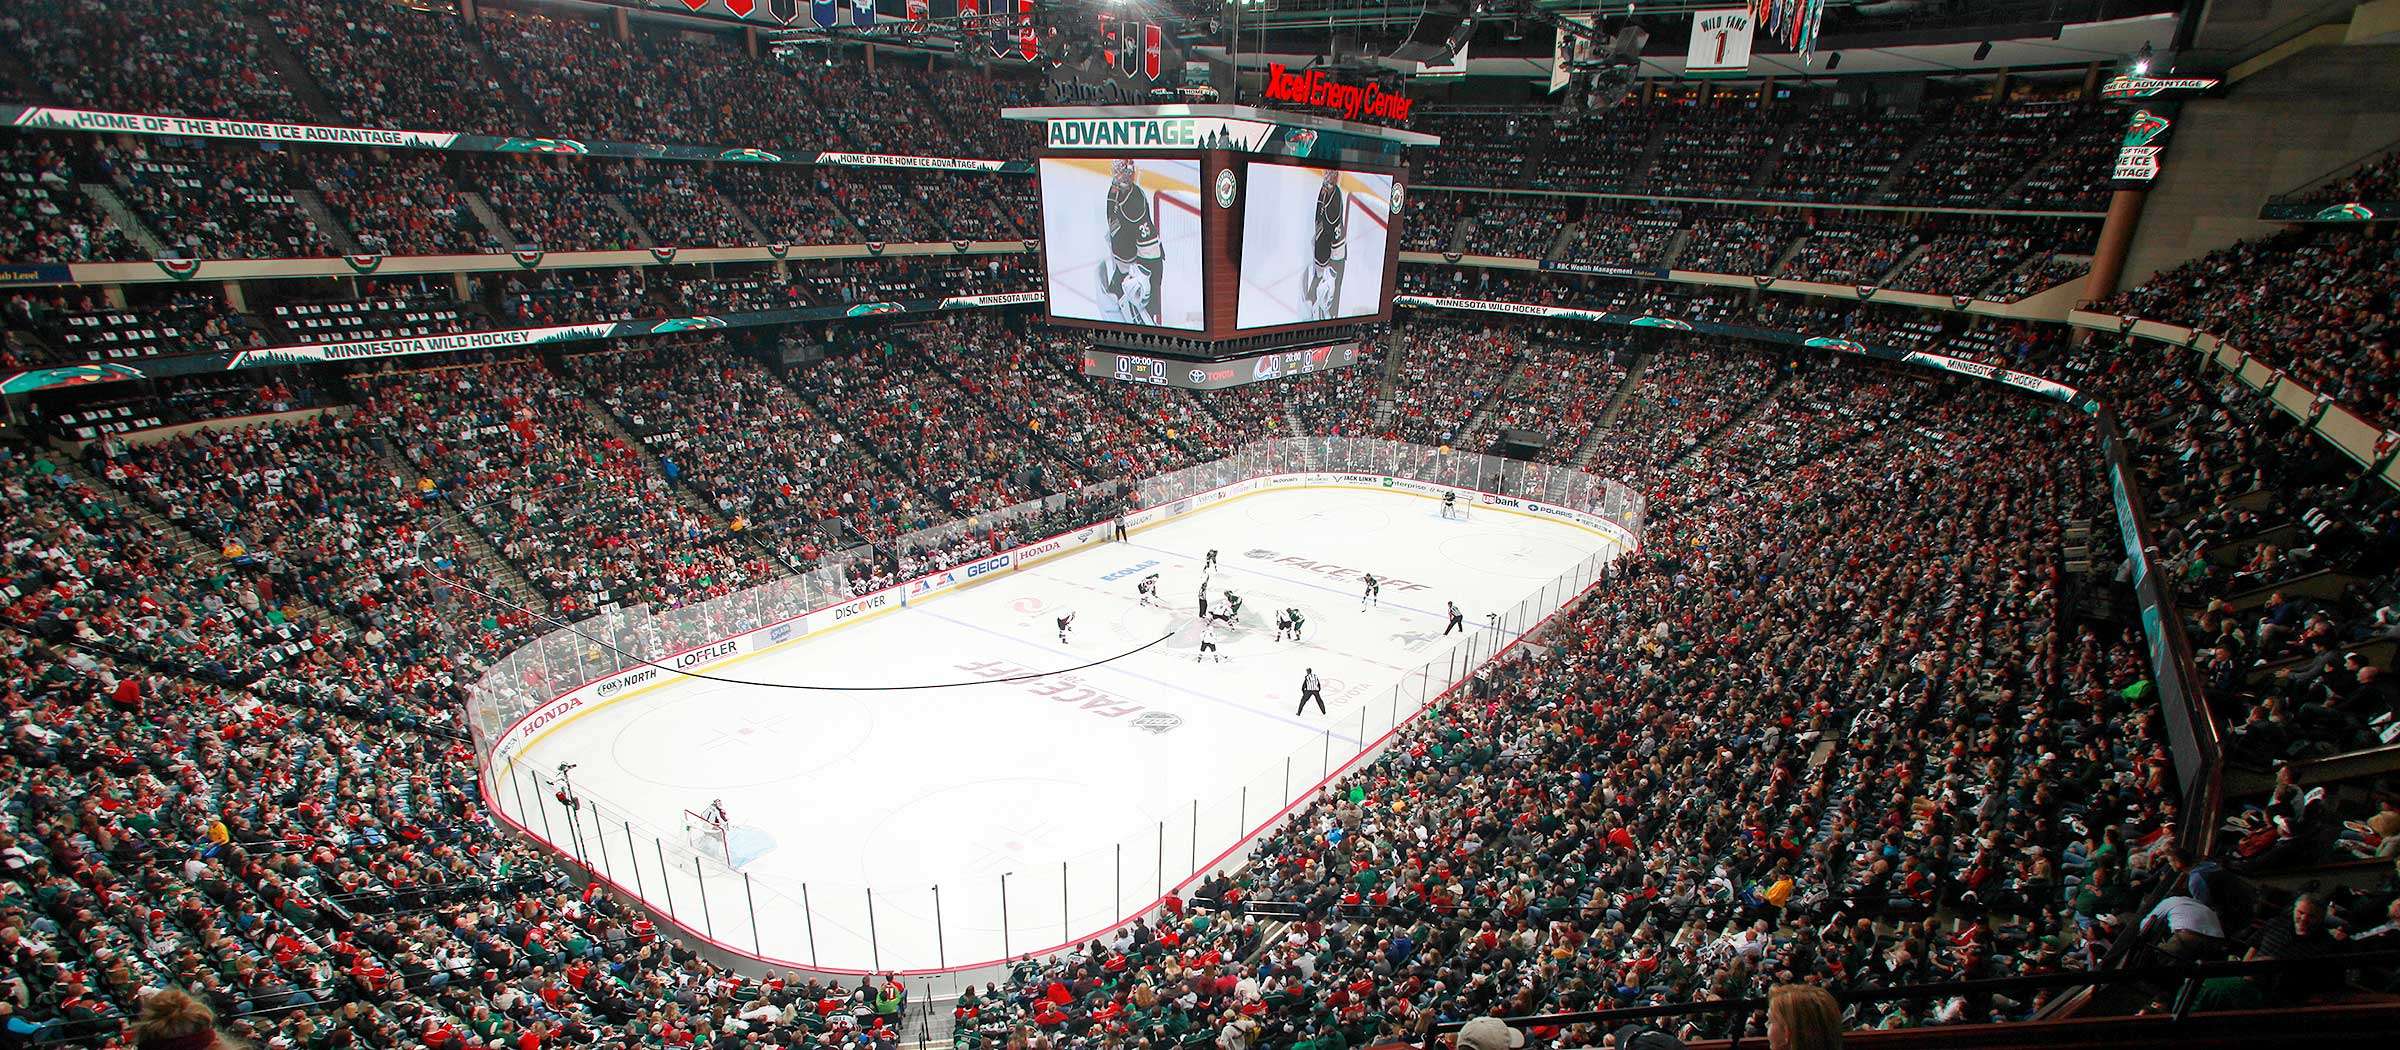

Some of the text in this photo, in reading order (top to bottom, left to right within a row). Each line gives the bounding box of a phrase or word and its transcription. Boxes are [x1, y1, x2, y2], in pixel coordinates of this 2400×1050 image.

[1701, 16, 1747, 32] WILD FANS
[1714, 30, 1728, 64] 1
[1264, 62, 1413, 121] Xcel Energy Center
[2133, 80, 2202, 88] ADVANTAGE
[77, 112, 402, 144] HOME OF THE HOME ICE ADVANTAGE
[1050, 120, 1195, 145] ADVANTAGE
[840, 154, 977, 169] HOME OF THE HOME ICE ADVANTAGE
[2130, 156, 2151, 166] ICE
[1139, 223, 1150, 239] 35
[1570, 264, 1592, 272] Wealth
[1592, 265, 1633, 275] Management
[979, 295, 1021, 305] MINNESOTA
[1021, 293, 1039, 302] WILD
[1435, 299, 1548, 315] MINNESOTA WILD HOCKEY
[323, 331, 530, 359] MINNESOTA WILD HOCKEY
[1119, 357, 1128, 372] 0
[1131, 355, 1152, 366] 20:00
[1540, 506, 1573, 519] POLARIS
[1020, 541, 1061, 560] HONDA
[967, 555, 1010, 578] GEICO
[835, 595, 886, 621] DISCOVER
[676, 641, 737, 669] LOFFLER
[602, 668, 657, 692] FOX NORTH
[522, 697, 583, 738] HONDA
